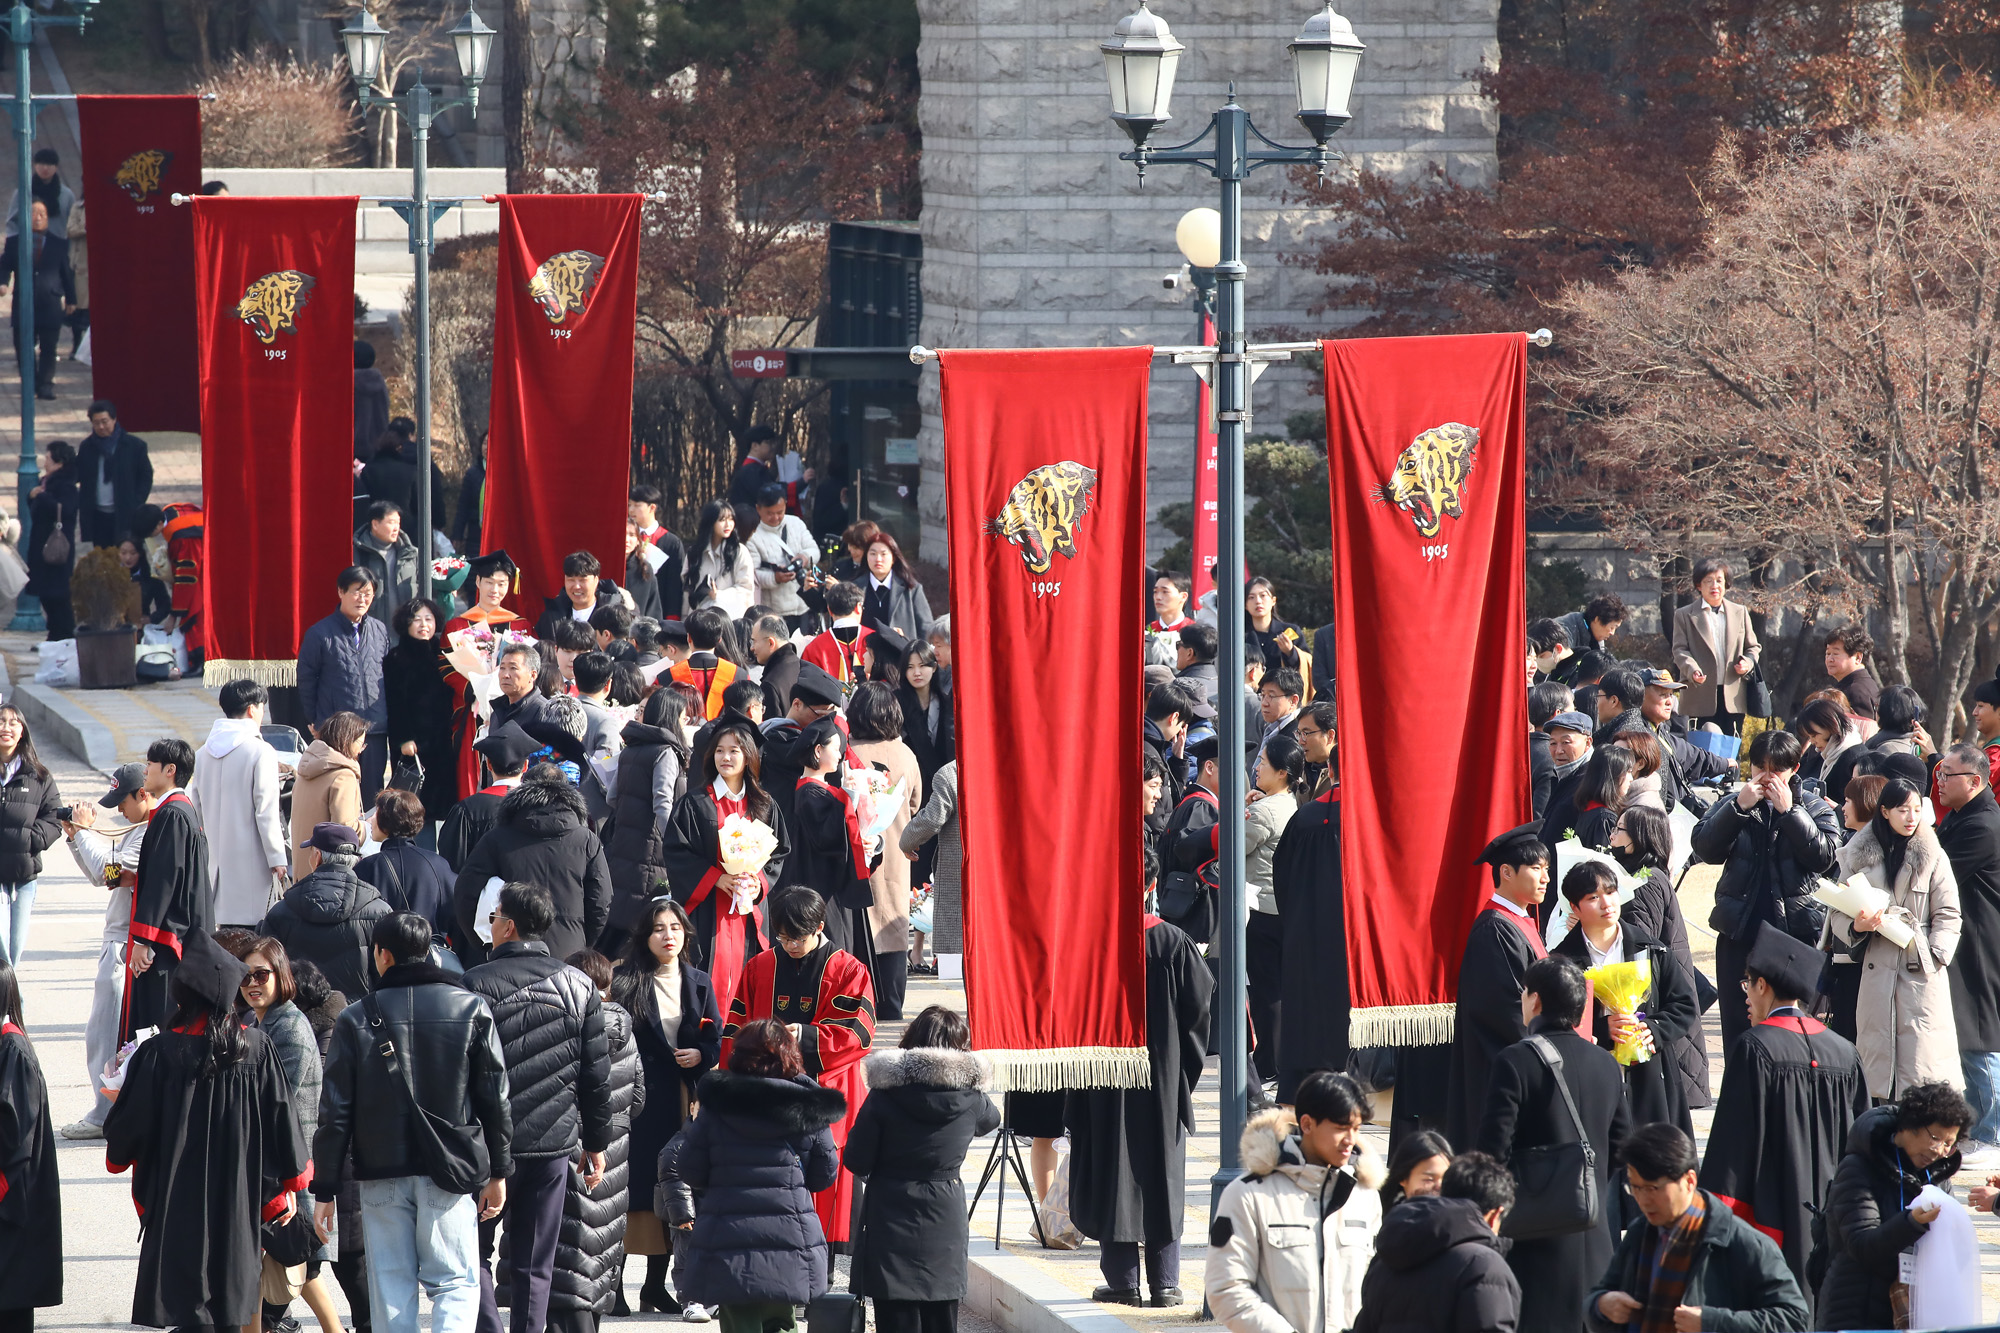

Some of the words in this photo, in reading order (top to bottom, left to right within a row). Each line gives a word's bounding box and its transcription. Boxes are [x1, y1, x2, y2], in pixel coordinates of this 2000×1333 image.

[136, 205, 155, 214] 1905
[551, 329, 572, 339] 1905
[264, 350, 287, 360] 1905
[734, 360, 753, 368] GATE
[1422, 544, 1448, 562] 1905
[1032, 582, 1062, 598] 1905
